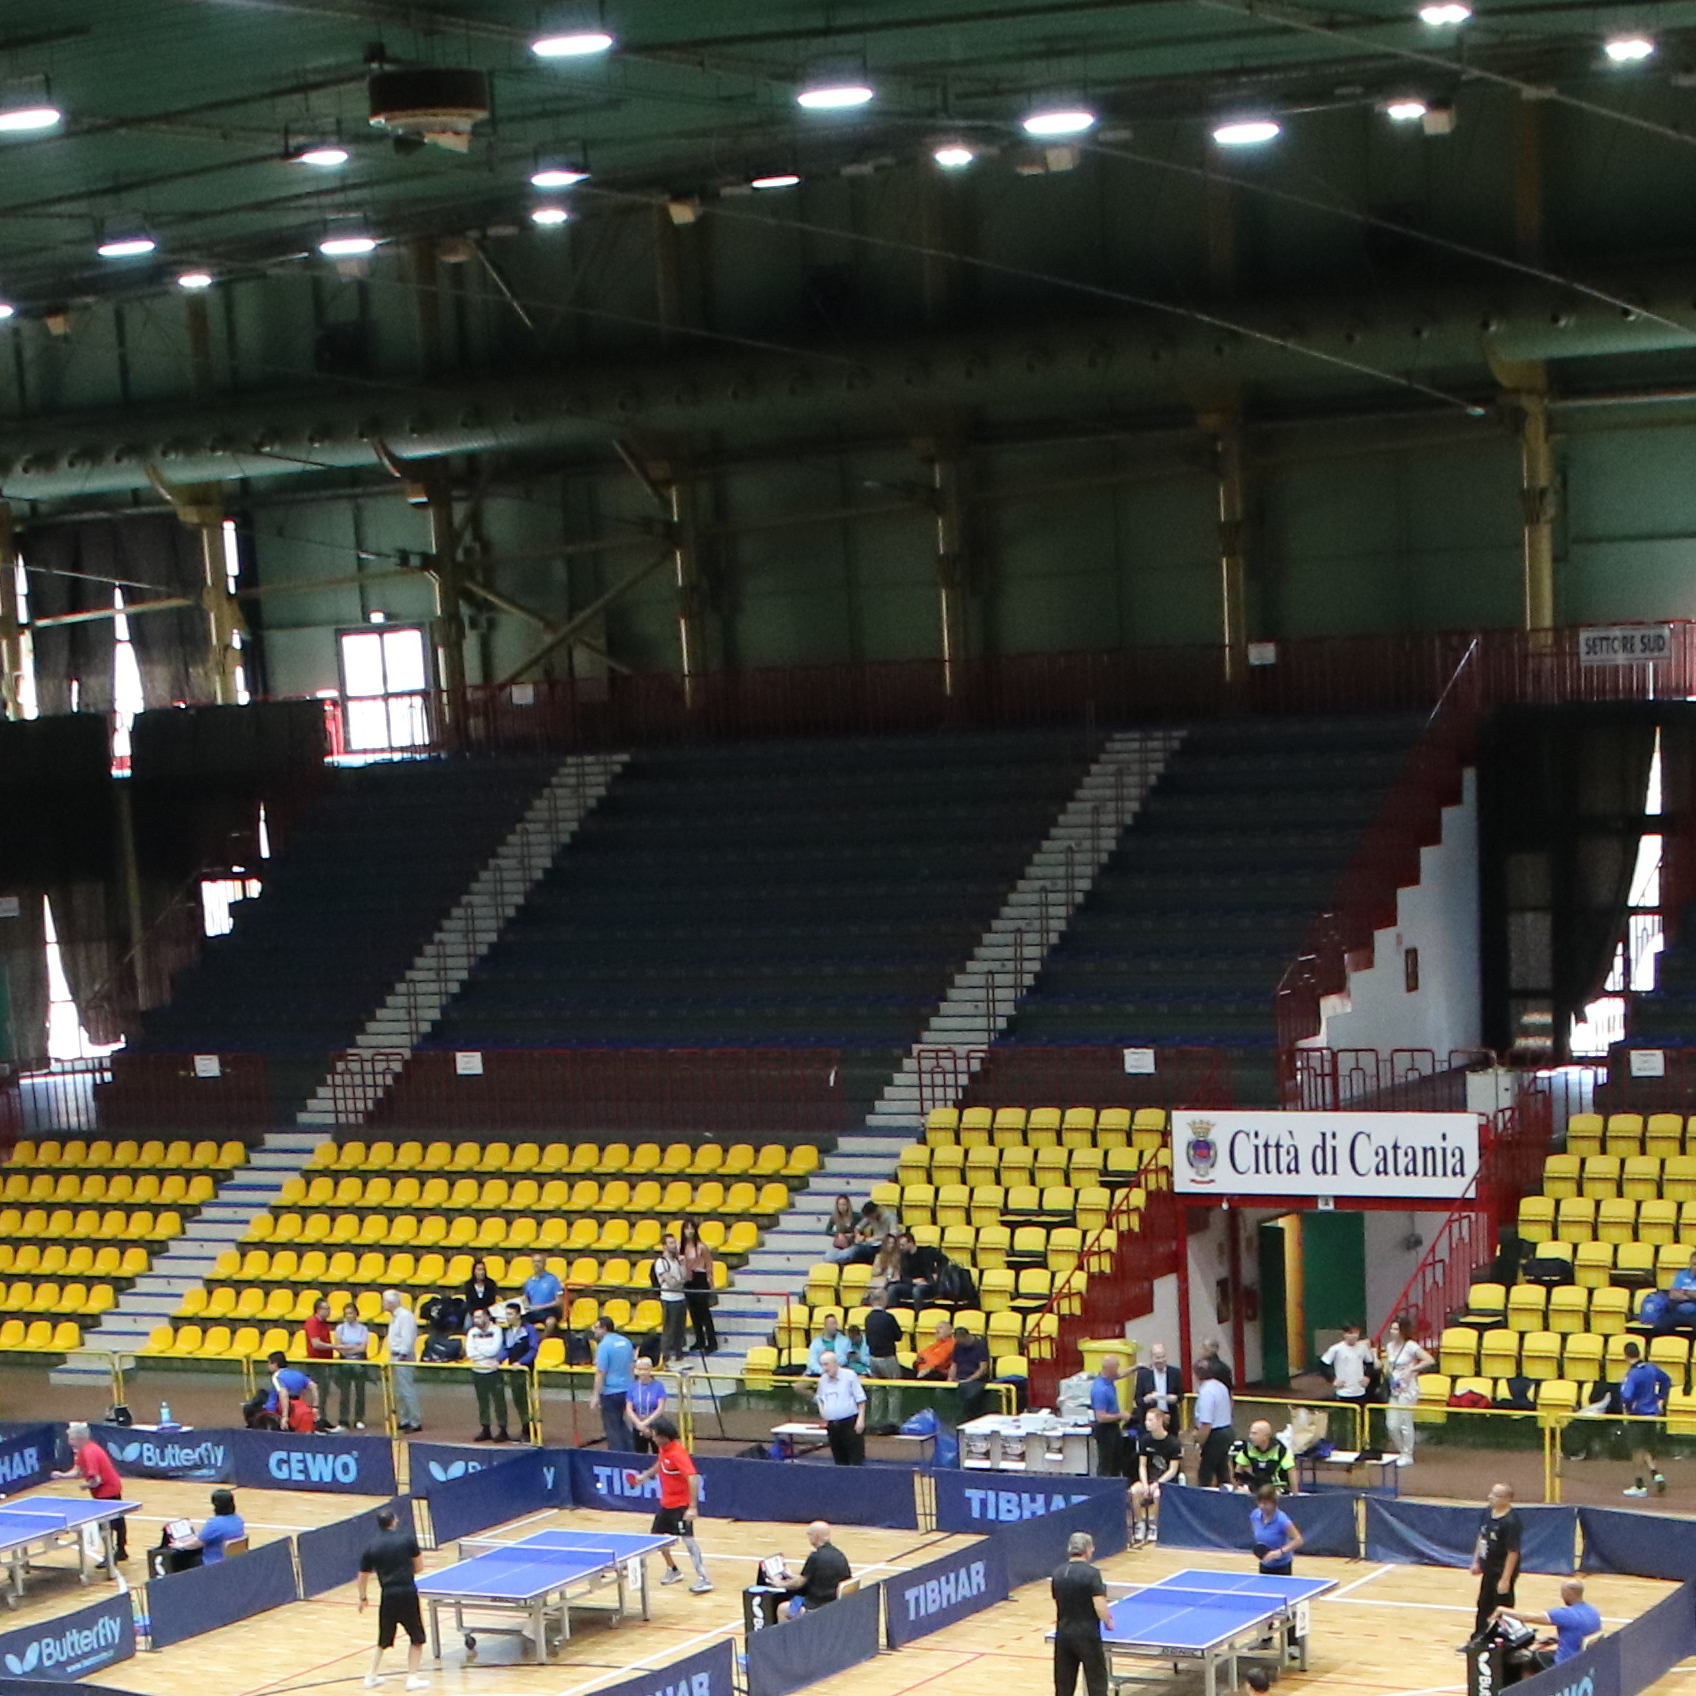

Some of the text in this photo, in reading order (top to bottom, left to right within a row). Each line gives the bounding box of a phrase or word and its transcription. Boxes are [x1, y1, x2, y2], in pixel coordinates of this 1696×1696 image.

[1584, 634, 1666, 655] SETTORE SUD
[1228, 1128, 1466, 1178] Città di Catania
[142, 1440, 225, 1470] Butterfly
[268, 1450, 357, 1483] GEWO
[905, 1560, 986, 1621] TIBHAR
[41, 1615, 122, 1667] Butterfly
